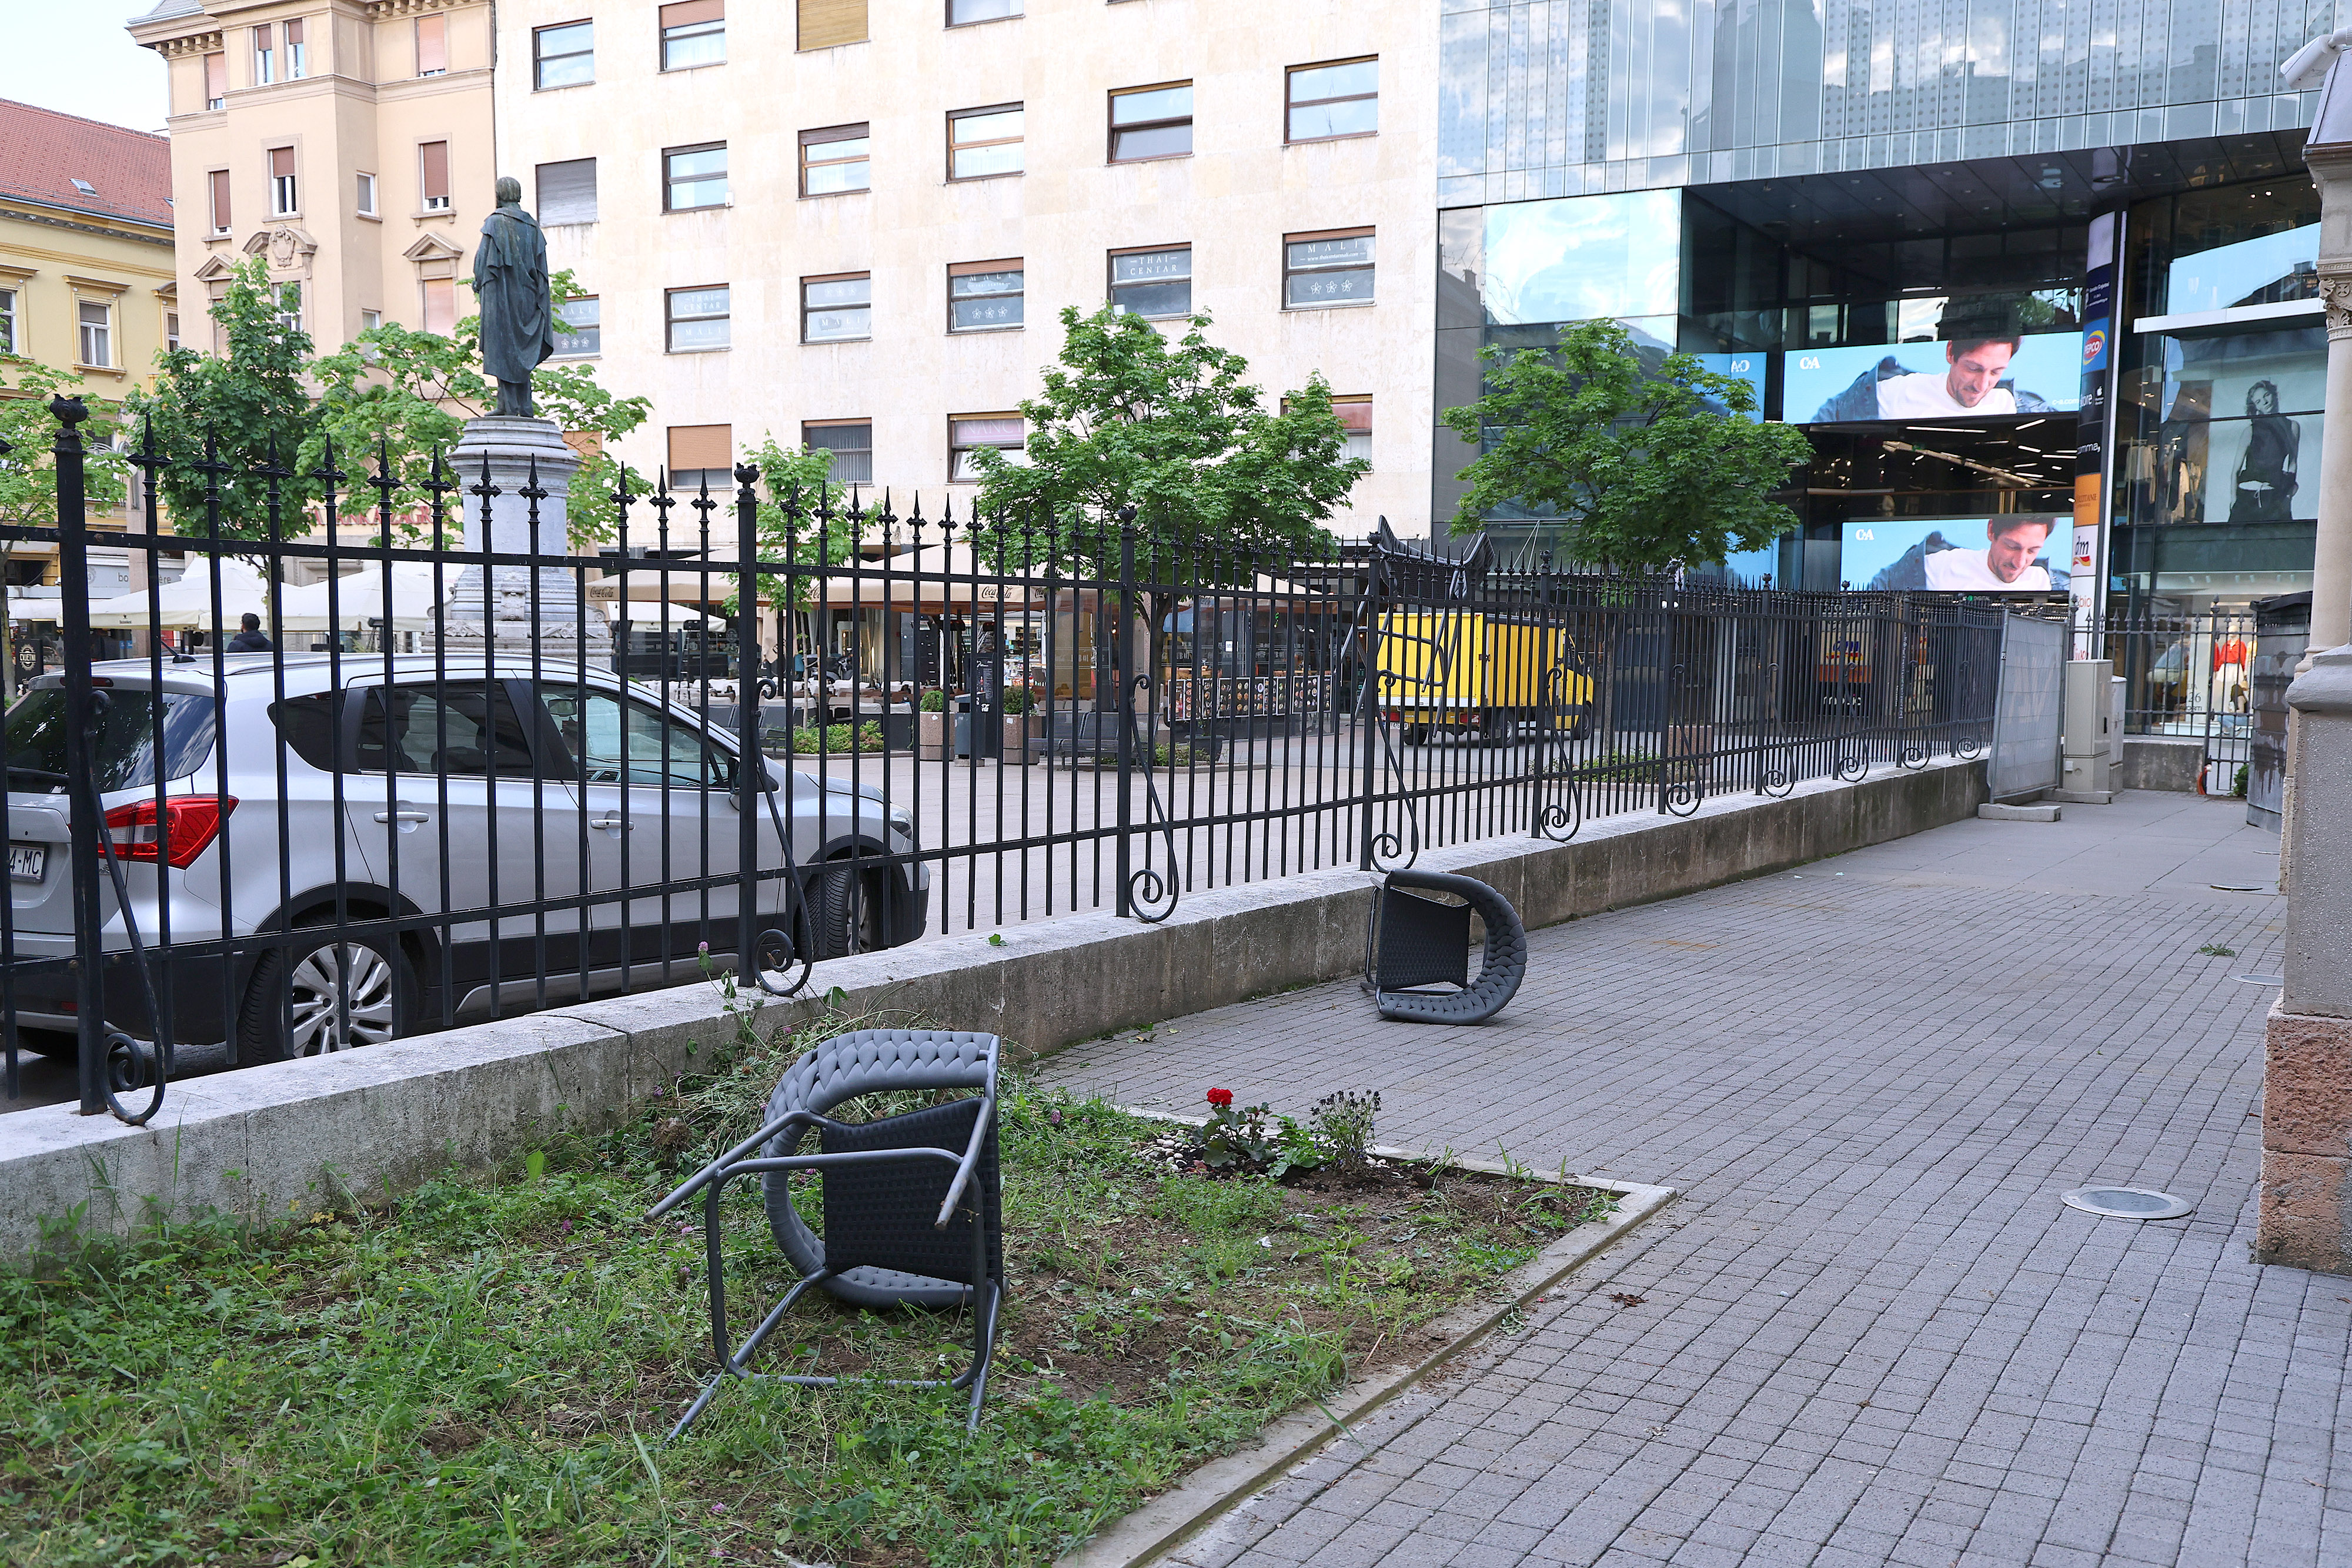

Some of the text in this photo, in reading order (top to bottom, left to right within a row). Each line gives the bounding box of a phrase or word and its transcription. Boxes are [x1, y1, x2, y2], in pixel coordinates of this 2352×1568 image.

[1308, 240, 1358, 253] MALI
[1140, 255, 1168, 265] THAI
[1130, 265, 1177, 275] CENTAR
[684, 301, 721, 312] CENTAR
[821, 316, 860, 326] MALI
[685, 326, 721, 335] MALI
[964, 419, 1023, 434] NANCY
[2075, 536, 2089, 556] dm
